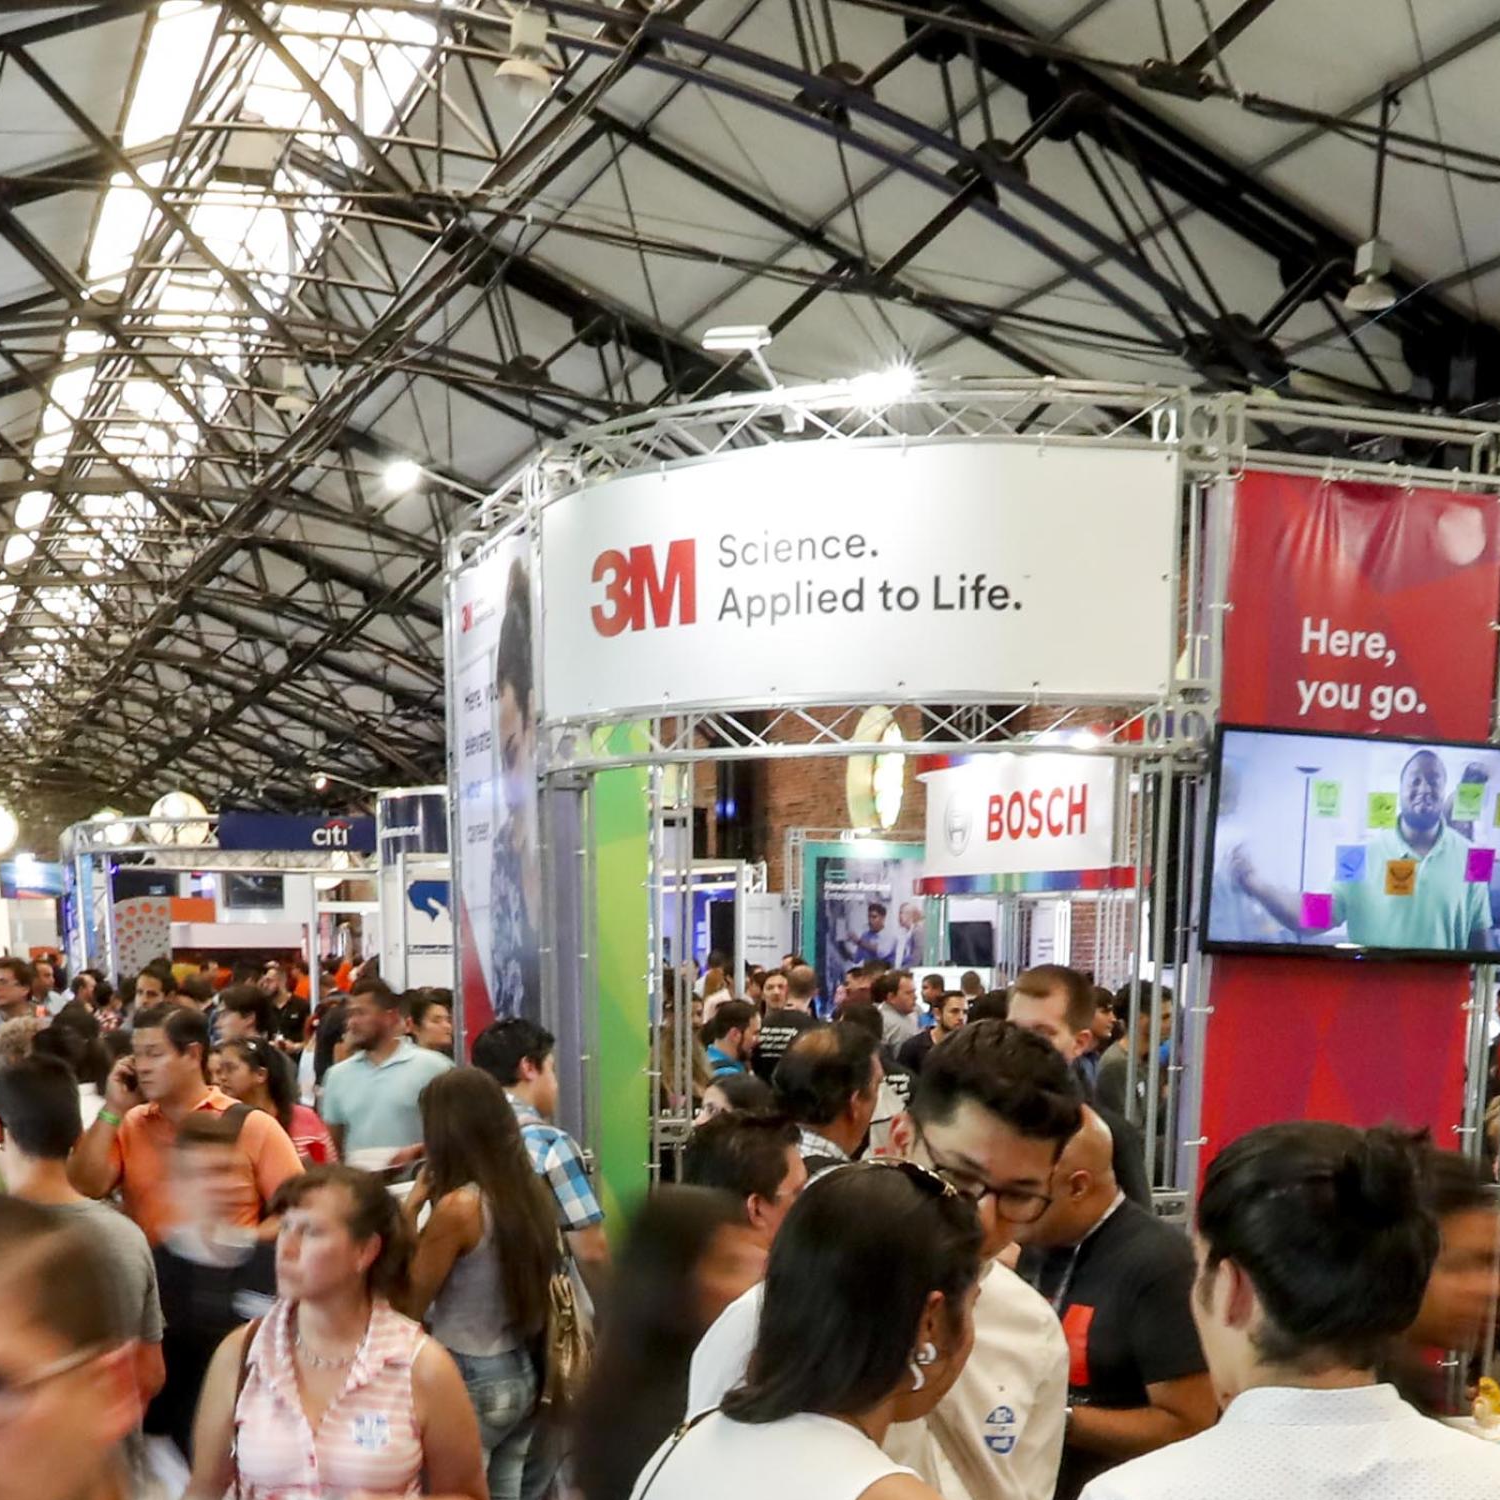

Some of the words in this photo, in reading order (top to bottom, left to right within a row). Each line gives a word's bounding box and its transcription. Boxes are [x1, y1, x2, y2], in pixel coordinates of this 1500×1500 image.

[717, 530, 880, 569] Science.
[590, 537, 697, 638] 3M
[717, 577, 866, 628] Applied
[879, 579, 921, 613] to
[932, 573, 1023, 612] Life.
[1299, 616, 1397, 668] Here,
[1296, 680, 1362, 716] you
[1368, 685, 1428, 721] go.
[311, 823, 349, 846] citi
[986, 783, 1089, 842] BOSCH
